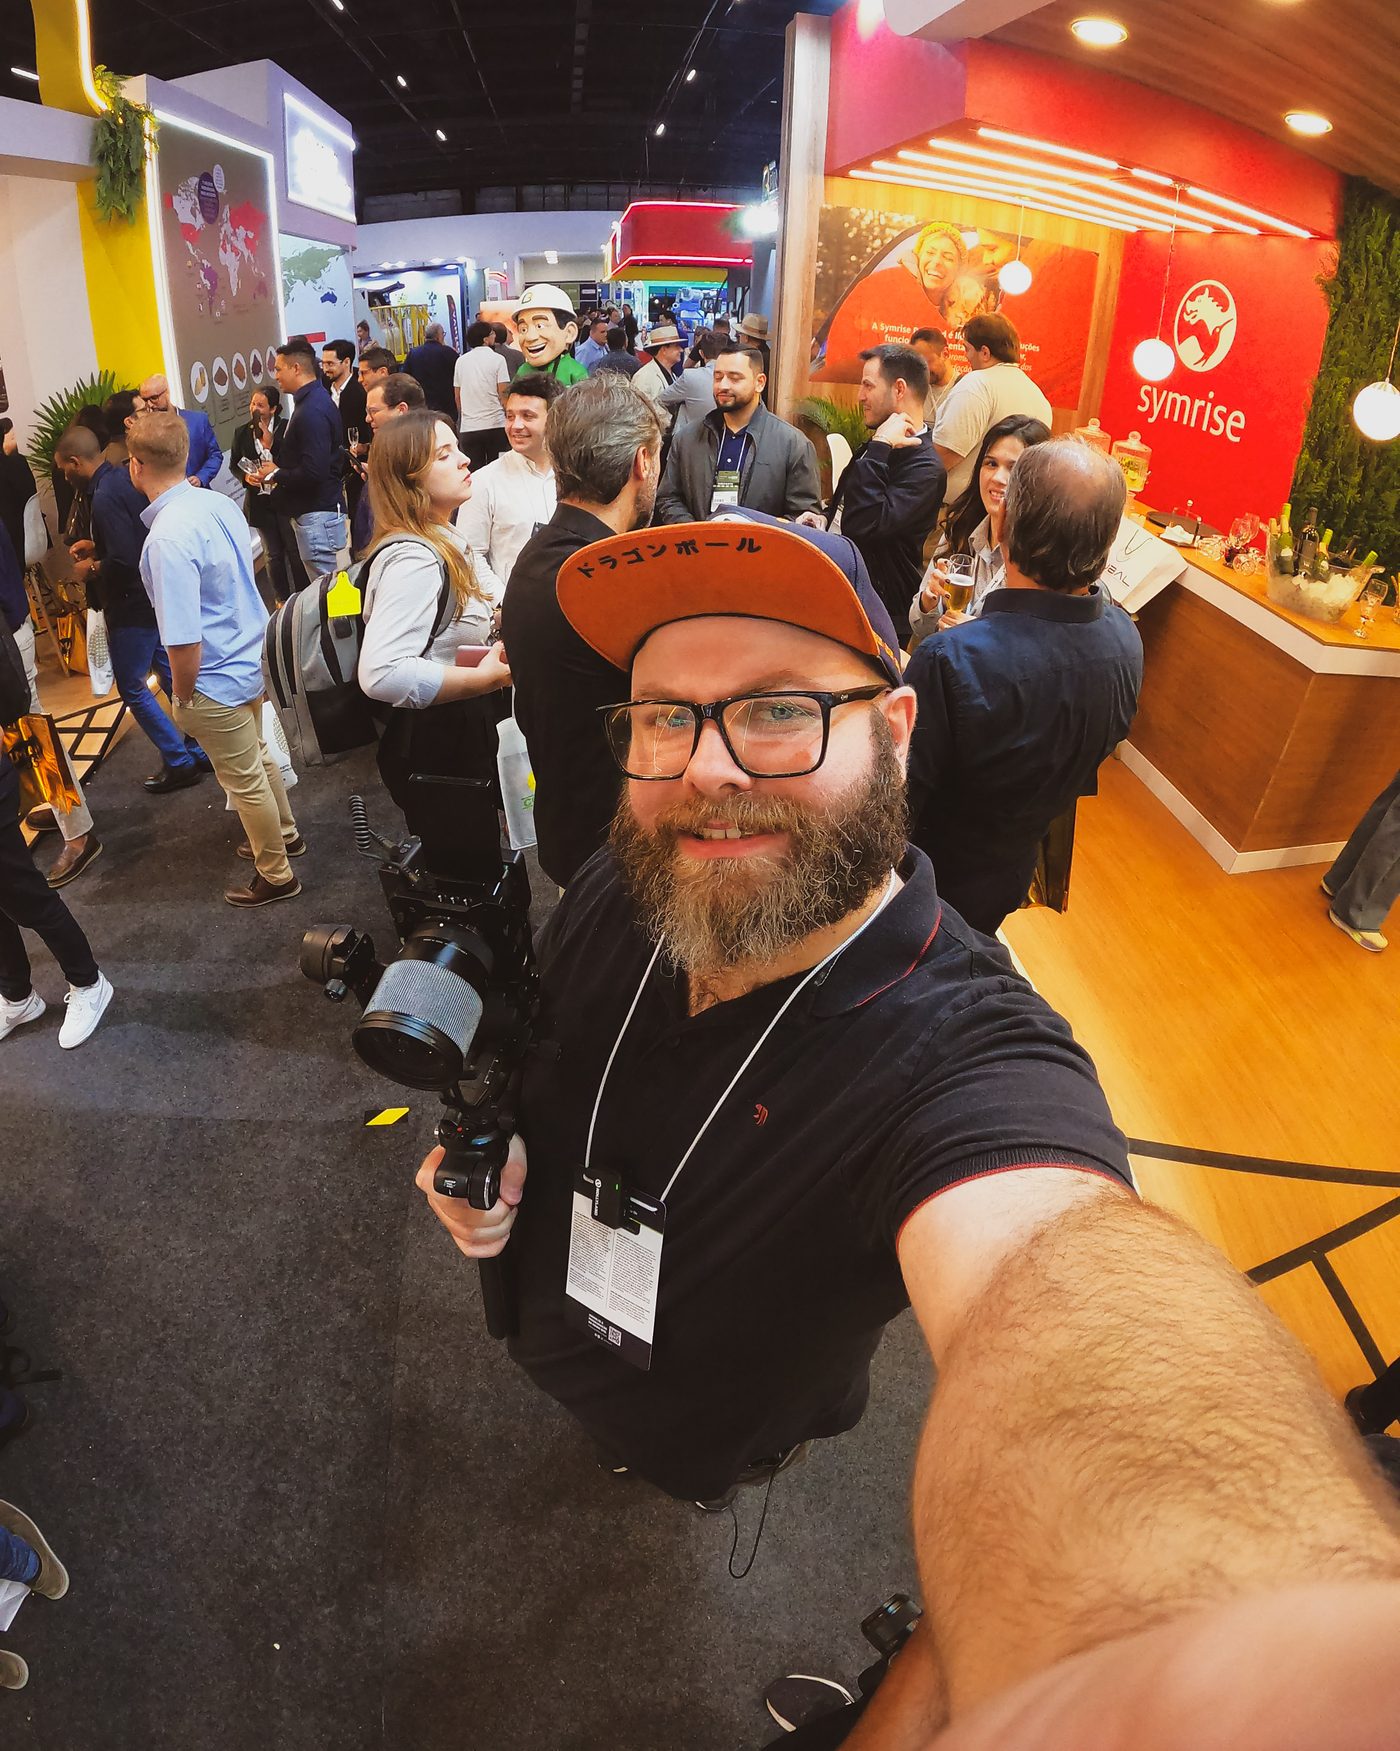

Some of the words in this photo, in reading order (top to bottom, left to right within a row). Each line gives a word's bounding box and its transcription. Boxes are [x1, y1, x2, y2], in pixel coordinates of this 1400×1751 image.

[872, 322, 878, 330] A
[880, 322, 911, 334] Symrise
[885, 334, 910, 344] funcio
[1019, 342, 1040, 352] uções
[1137, 384, 1246, 443] symrise
[577, 537, 762, 579] ドラゴンボール
